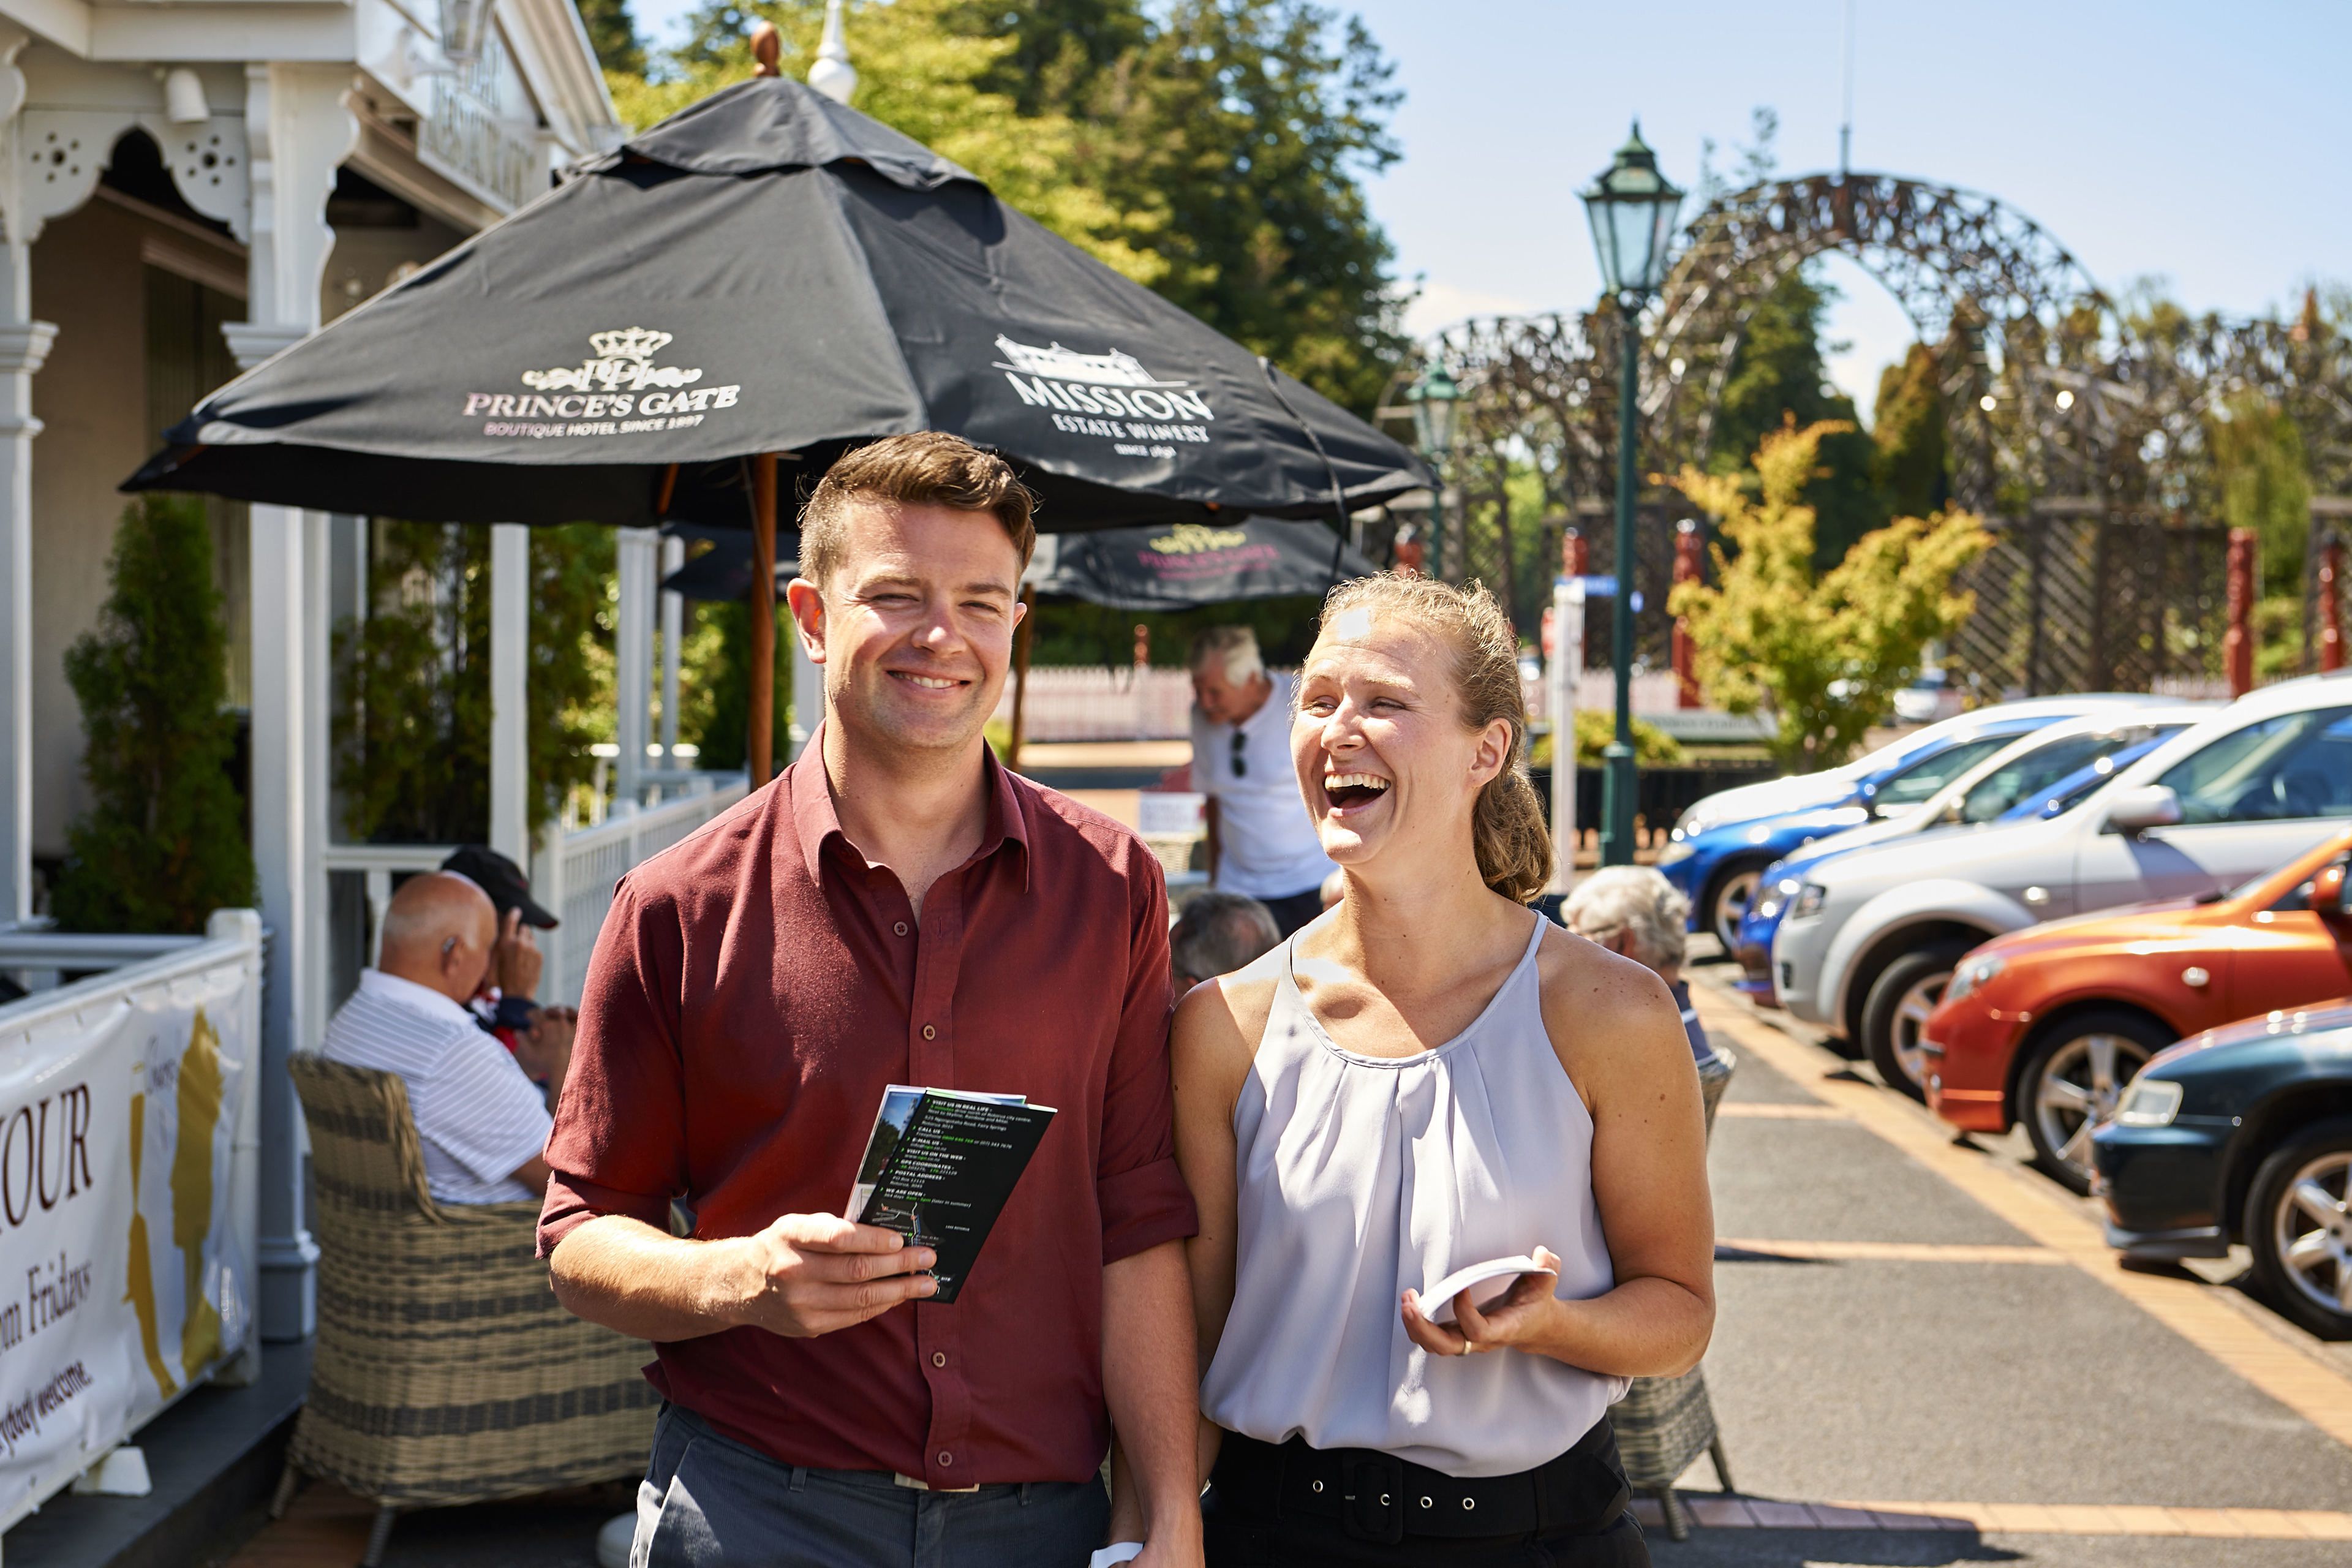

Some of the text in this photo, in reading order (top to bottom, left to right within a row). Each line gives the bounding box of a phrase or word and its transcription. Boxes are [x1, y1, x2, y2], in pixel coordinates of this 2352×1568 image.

[462, 384, 741, 418] PRINCE'S GATE
[1005, 371, 1215, 421] MISSION
[483, 421, 566, 439] BOUTIQUE
[566, 421, 617, 436] HOTEL
[619, 418, 666, 434] SINCE
[1051, 413, 1211, 443] ESTATE WINERY
[0, 1082, 93, 1235] OUR
[913, 1161, 952, 1169] COORDINATES
